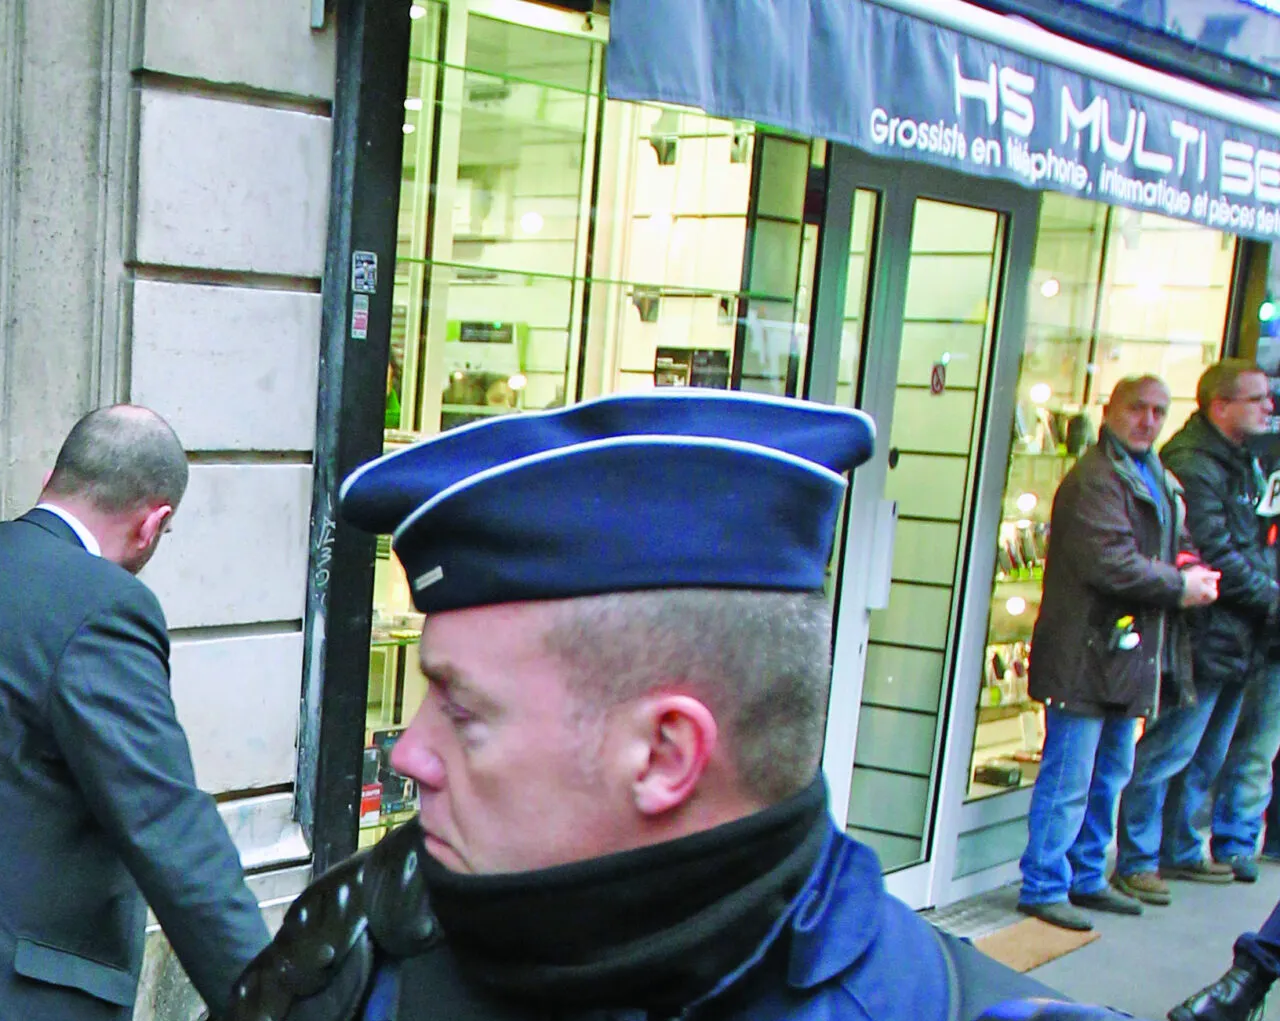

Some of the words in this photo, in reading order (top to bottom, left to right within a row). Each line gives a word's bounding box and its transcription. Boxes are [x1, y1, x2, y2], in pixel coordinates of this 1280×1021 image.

[870, 107, 967, 160] Grossiste
[971, 136, 1002, 168] en
[1192, 190, 1209, 219] et
[953, 53, 1035, 137] HS
[1060, 85, 1207, 184] MULTI
